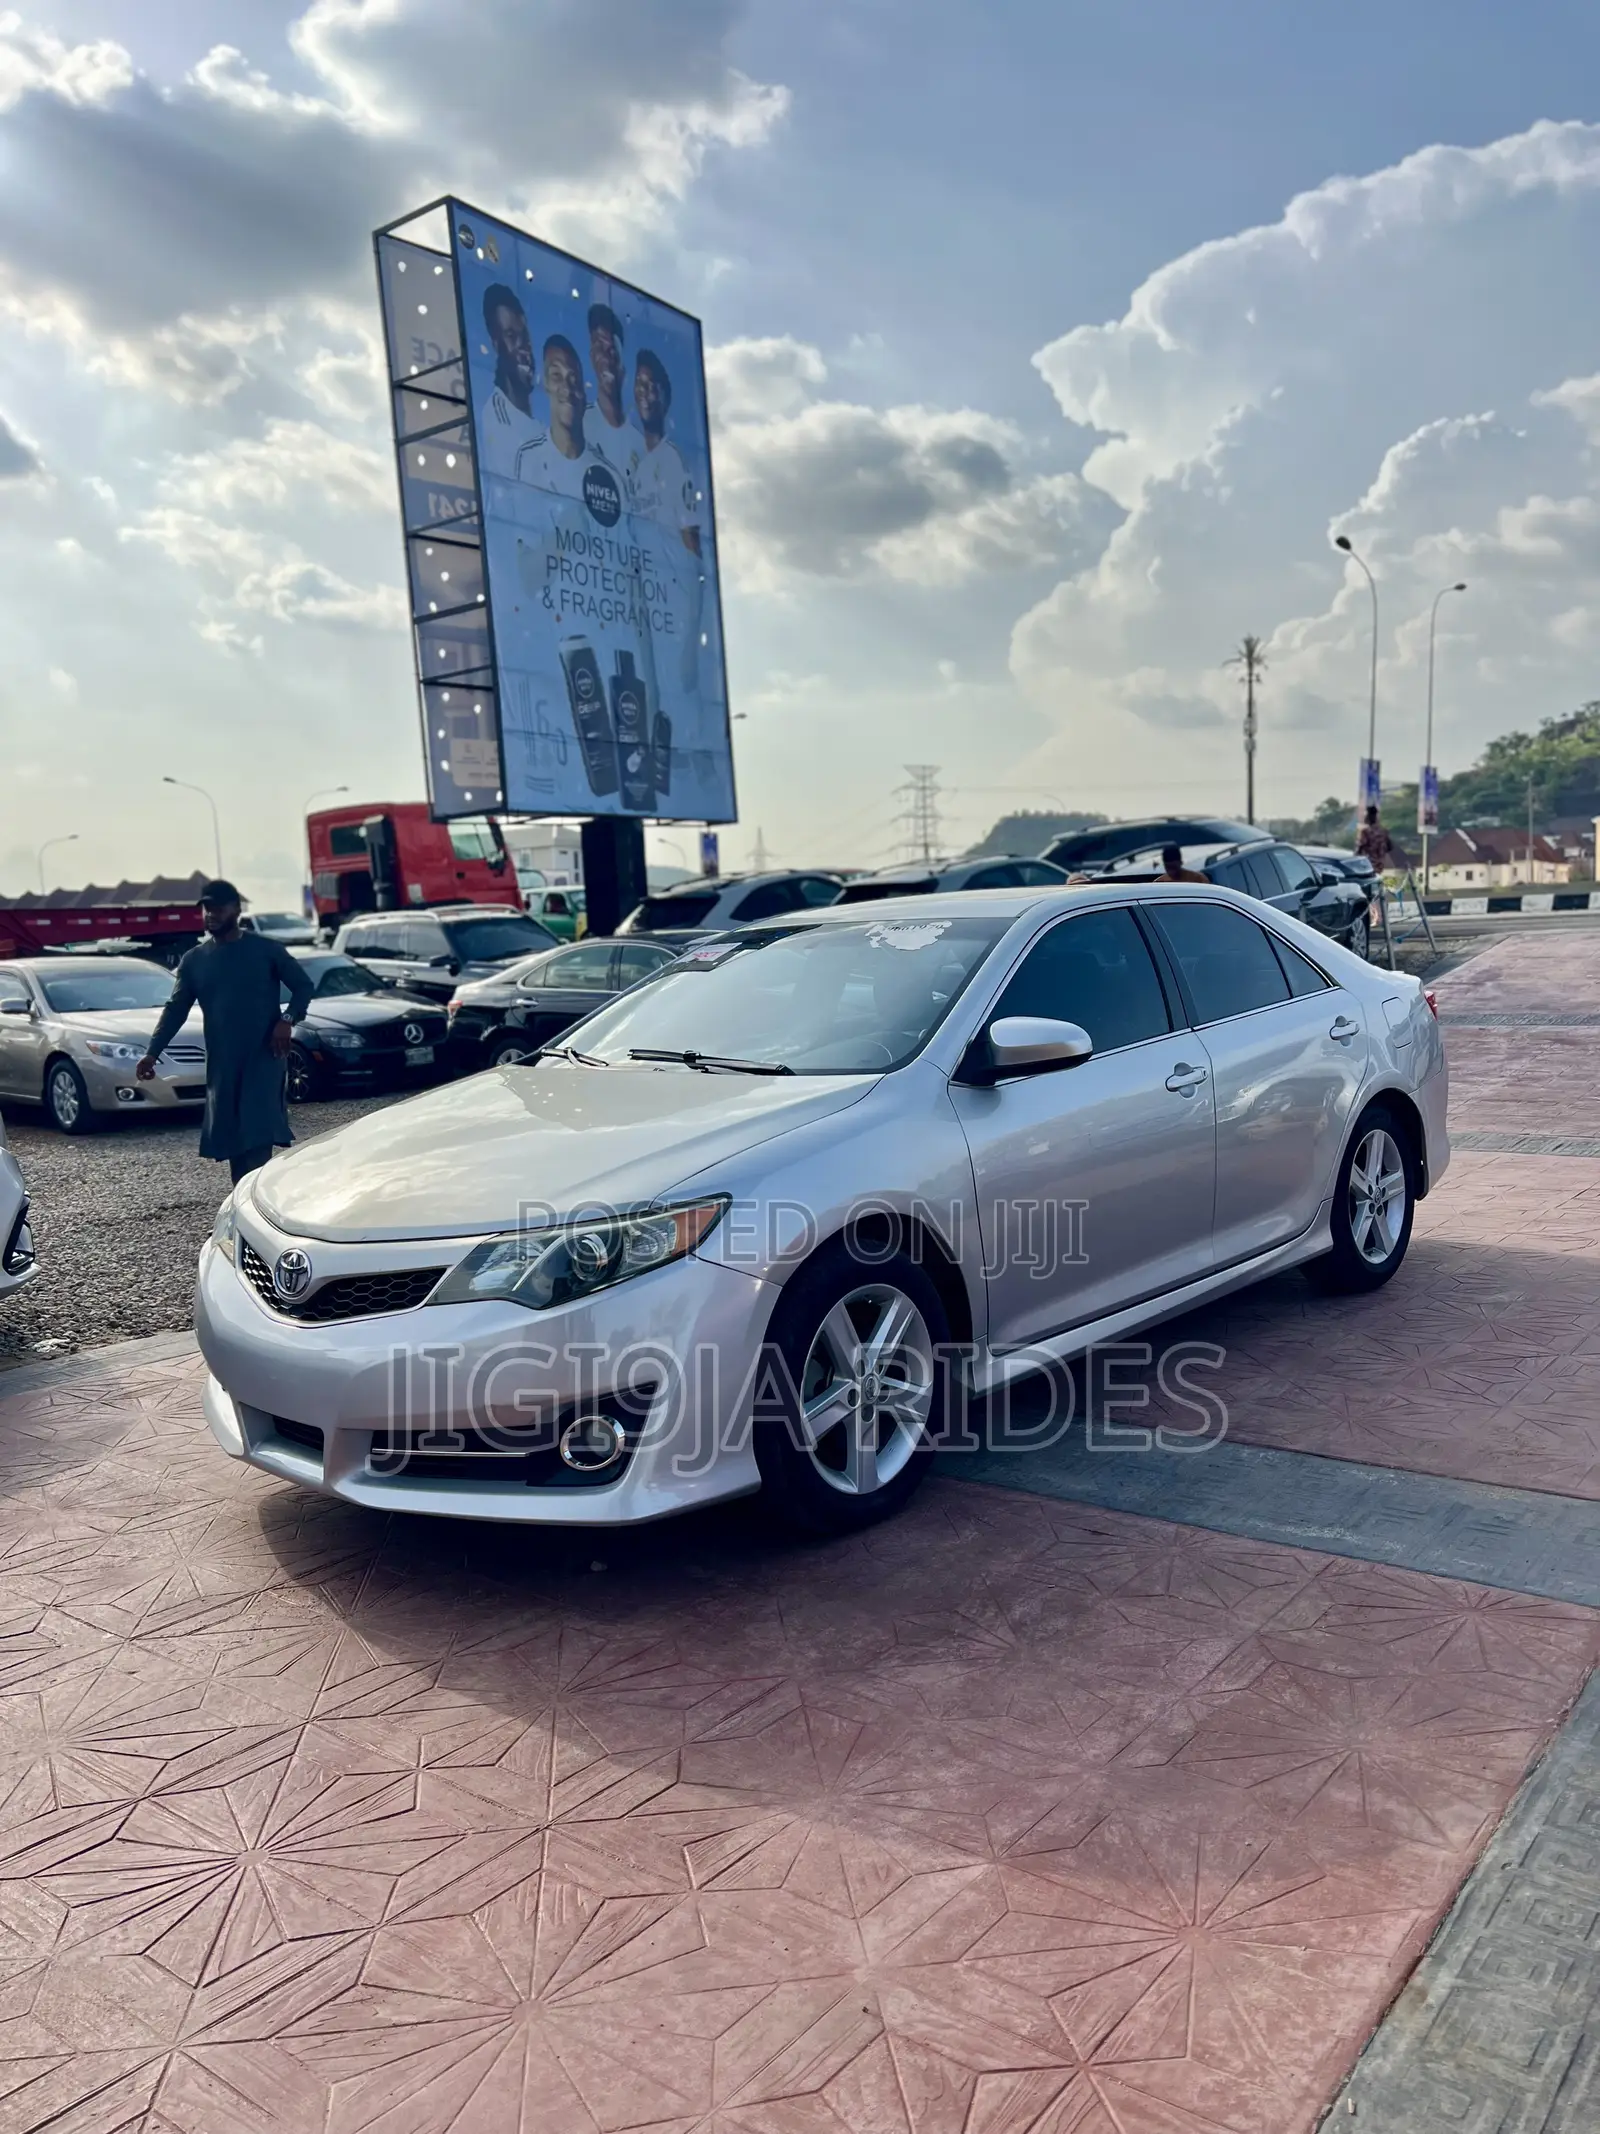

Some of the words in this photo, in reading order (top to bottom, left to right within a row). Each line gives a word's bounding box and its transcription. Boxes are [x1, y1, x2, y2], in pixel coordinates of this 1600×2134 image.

[586, 482, 618, 504] NIVEA
[555, 525, 658, 578] MOISTURE,
[545, 553, 668, 605] PROTECTION
[541, 584, 555, 610] &
[560, 588, 676, 635] FRAGRANCE
